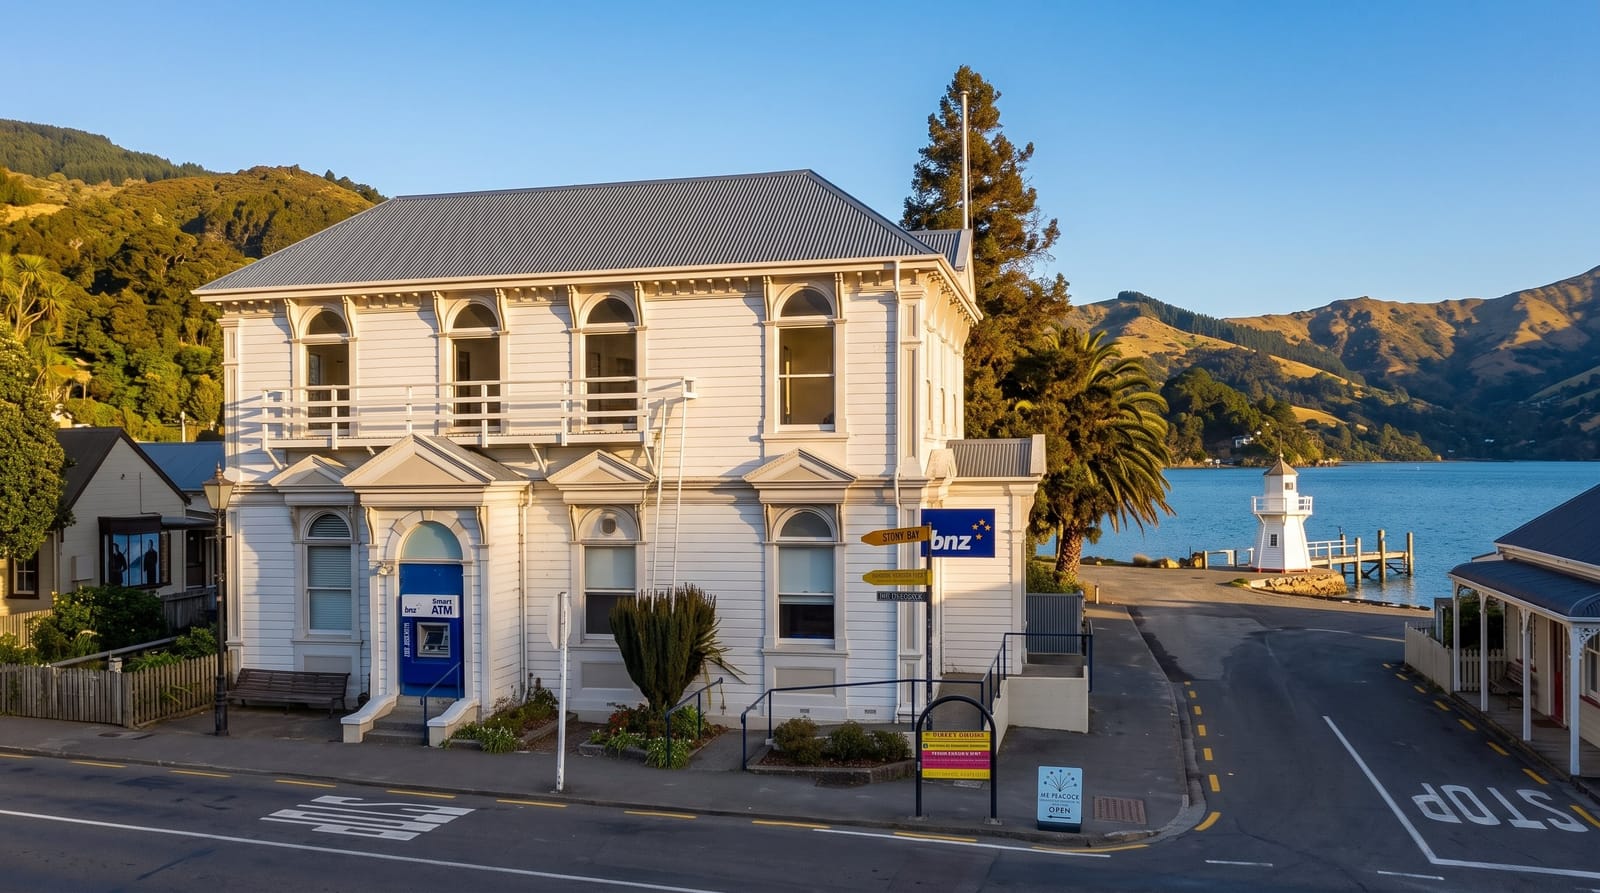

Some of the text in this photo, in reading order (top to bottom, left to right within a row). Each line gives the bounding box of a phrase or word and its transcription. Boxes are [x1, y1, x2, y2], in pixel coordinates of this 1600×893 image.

[882, 530, 920, 542] STONY BAY
[930, 529, 972, 550] bnz
[431, 605, 452, 615] ATM
[1411, 782, 1590, 833] STOP
